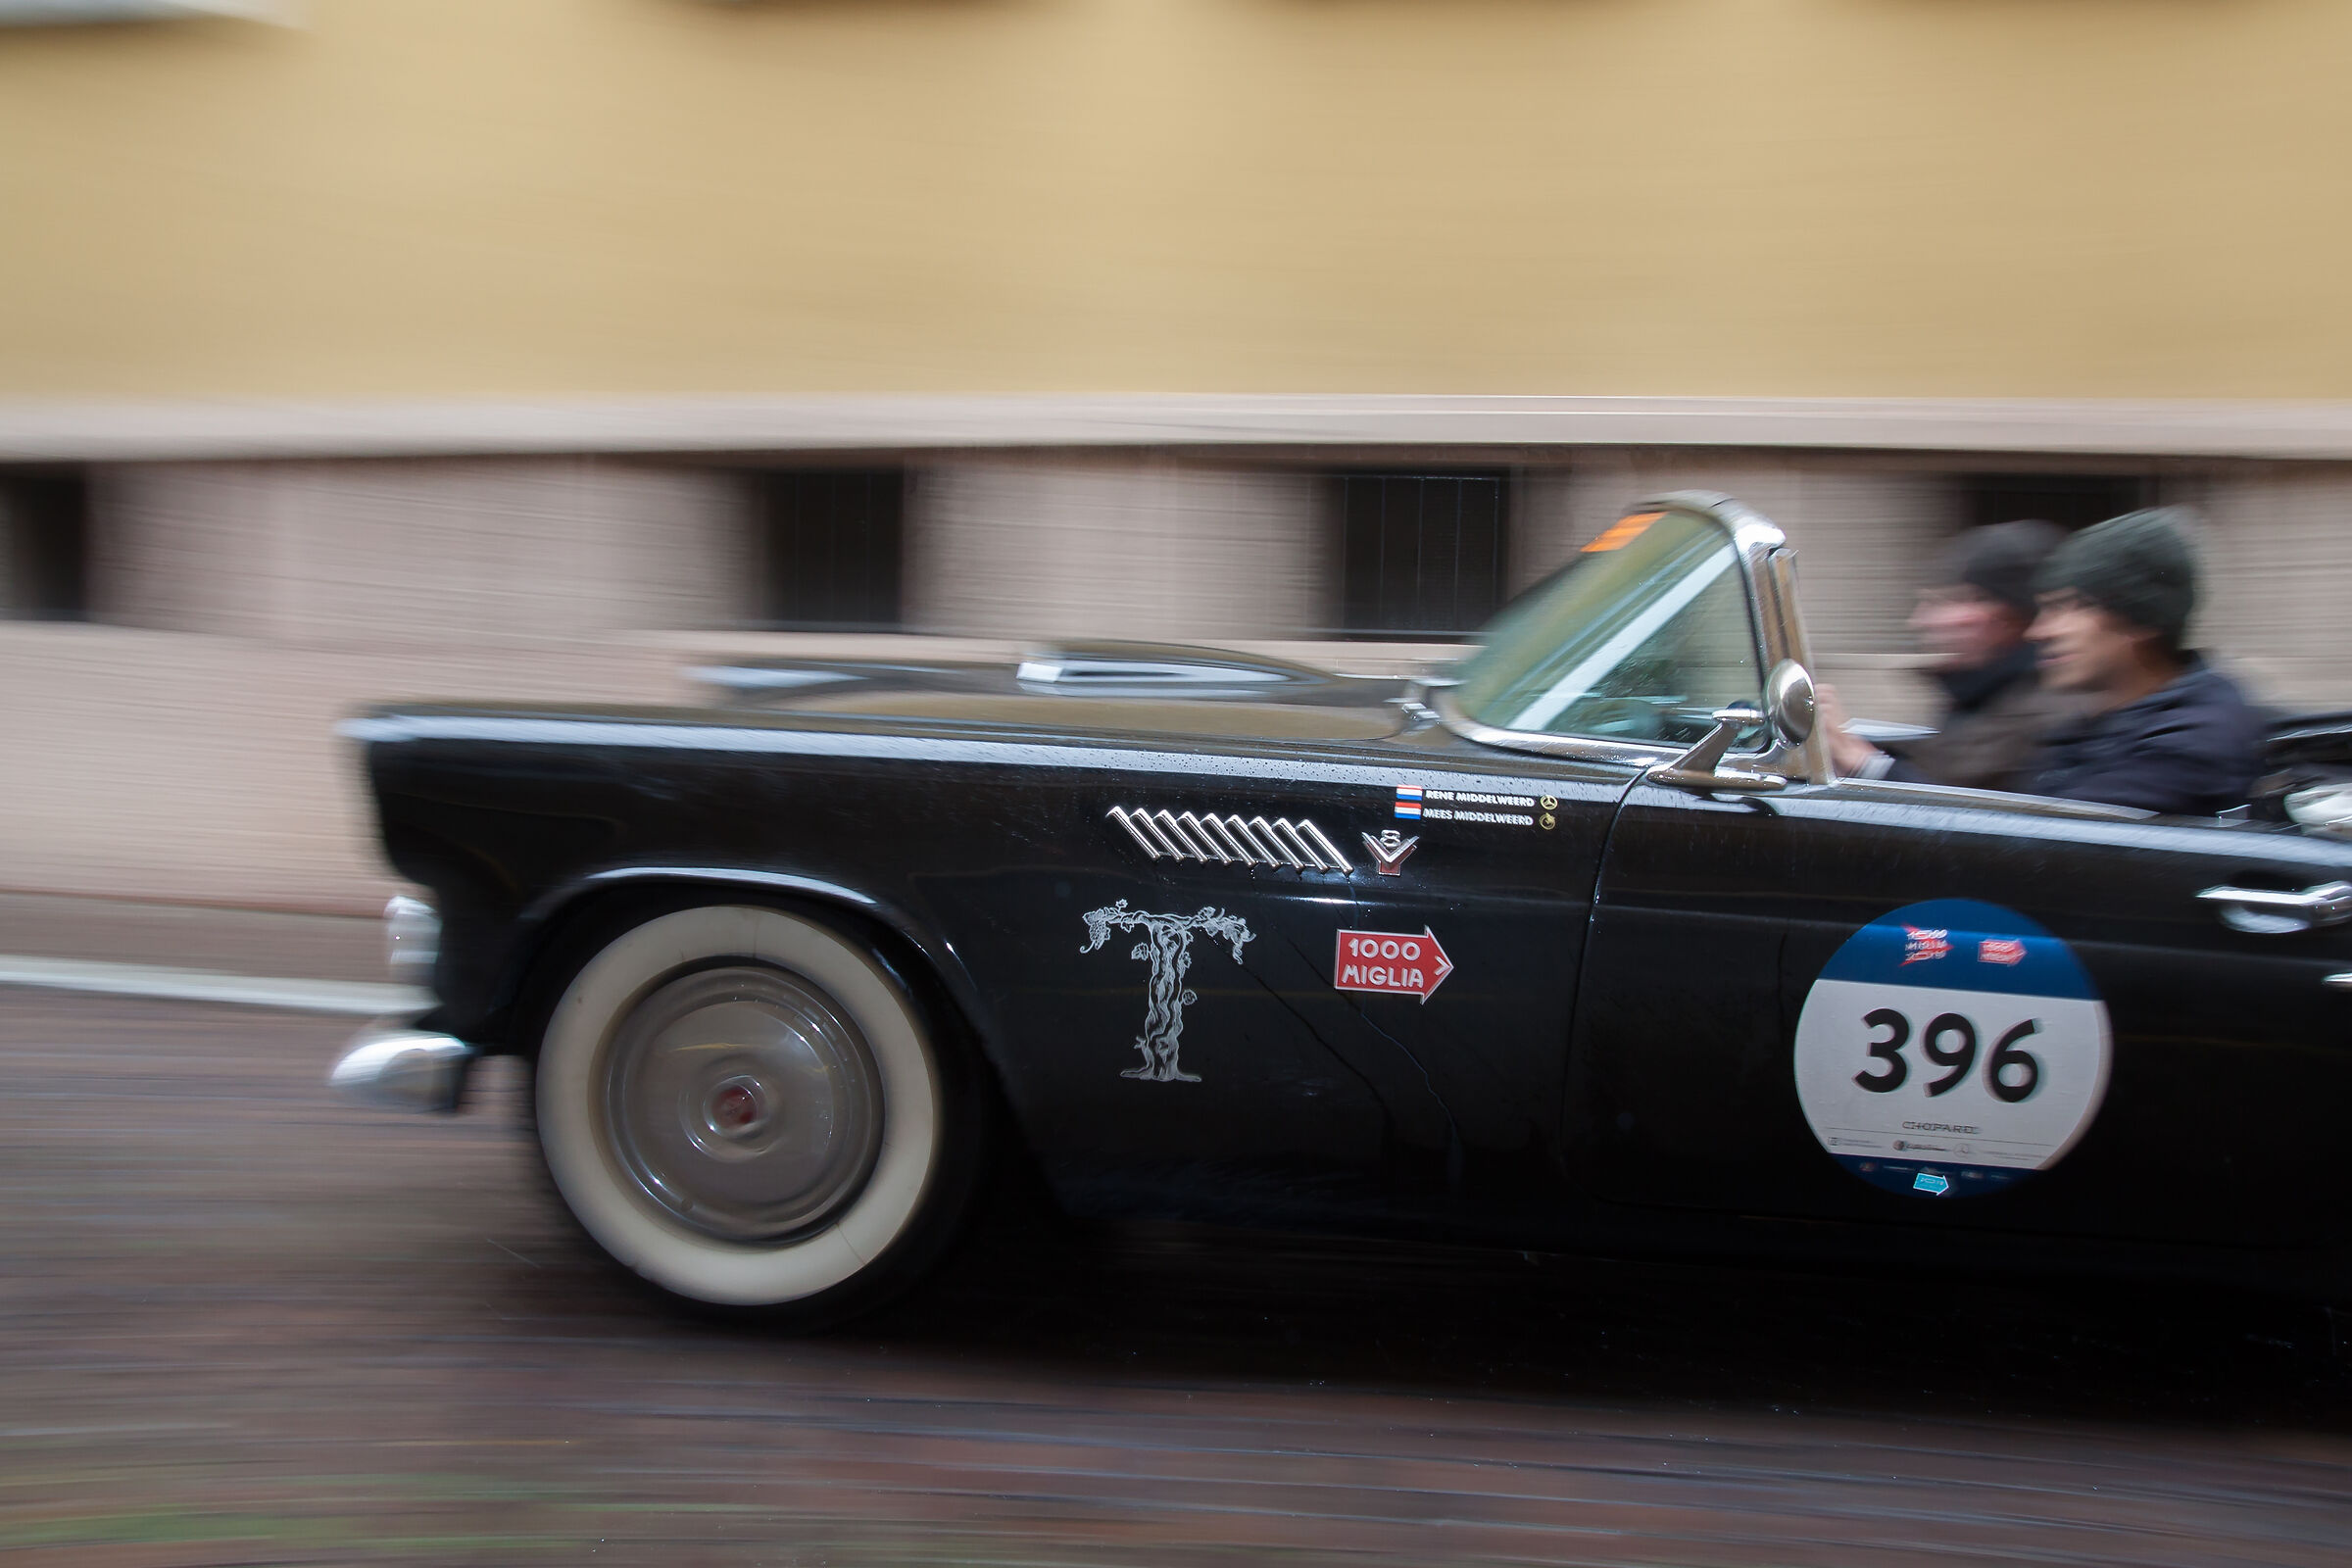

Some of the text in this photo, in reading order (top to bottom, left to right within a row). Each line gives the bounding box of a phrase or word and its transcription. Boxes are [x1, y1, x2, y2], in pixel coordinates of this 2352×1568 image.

[1425, 789, 1536, 808] RENE MIDDELWEERD
[1422, 808, 1535, 826] MEES MIDDELWEERD
[1348, 937, 1421, 961] 1000
[1341, 963, 1424, 989] MIGLIA
[1852, 1007, 2042, 1103] 396
[1901, 1120, 1984, 1135] CHOPARD
